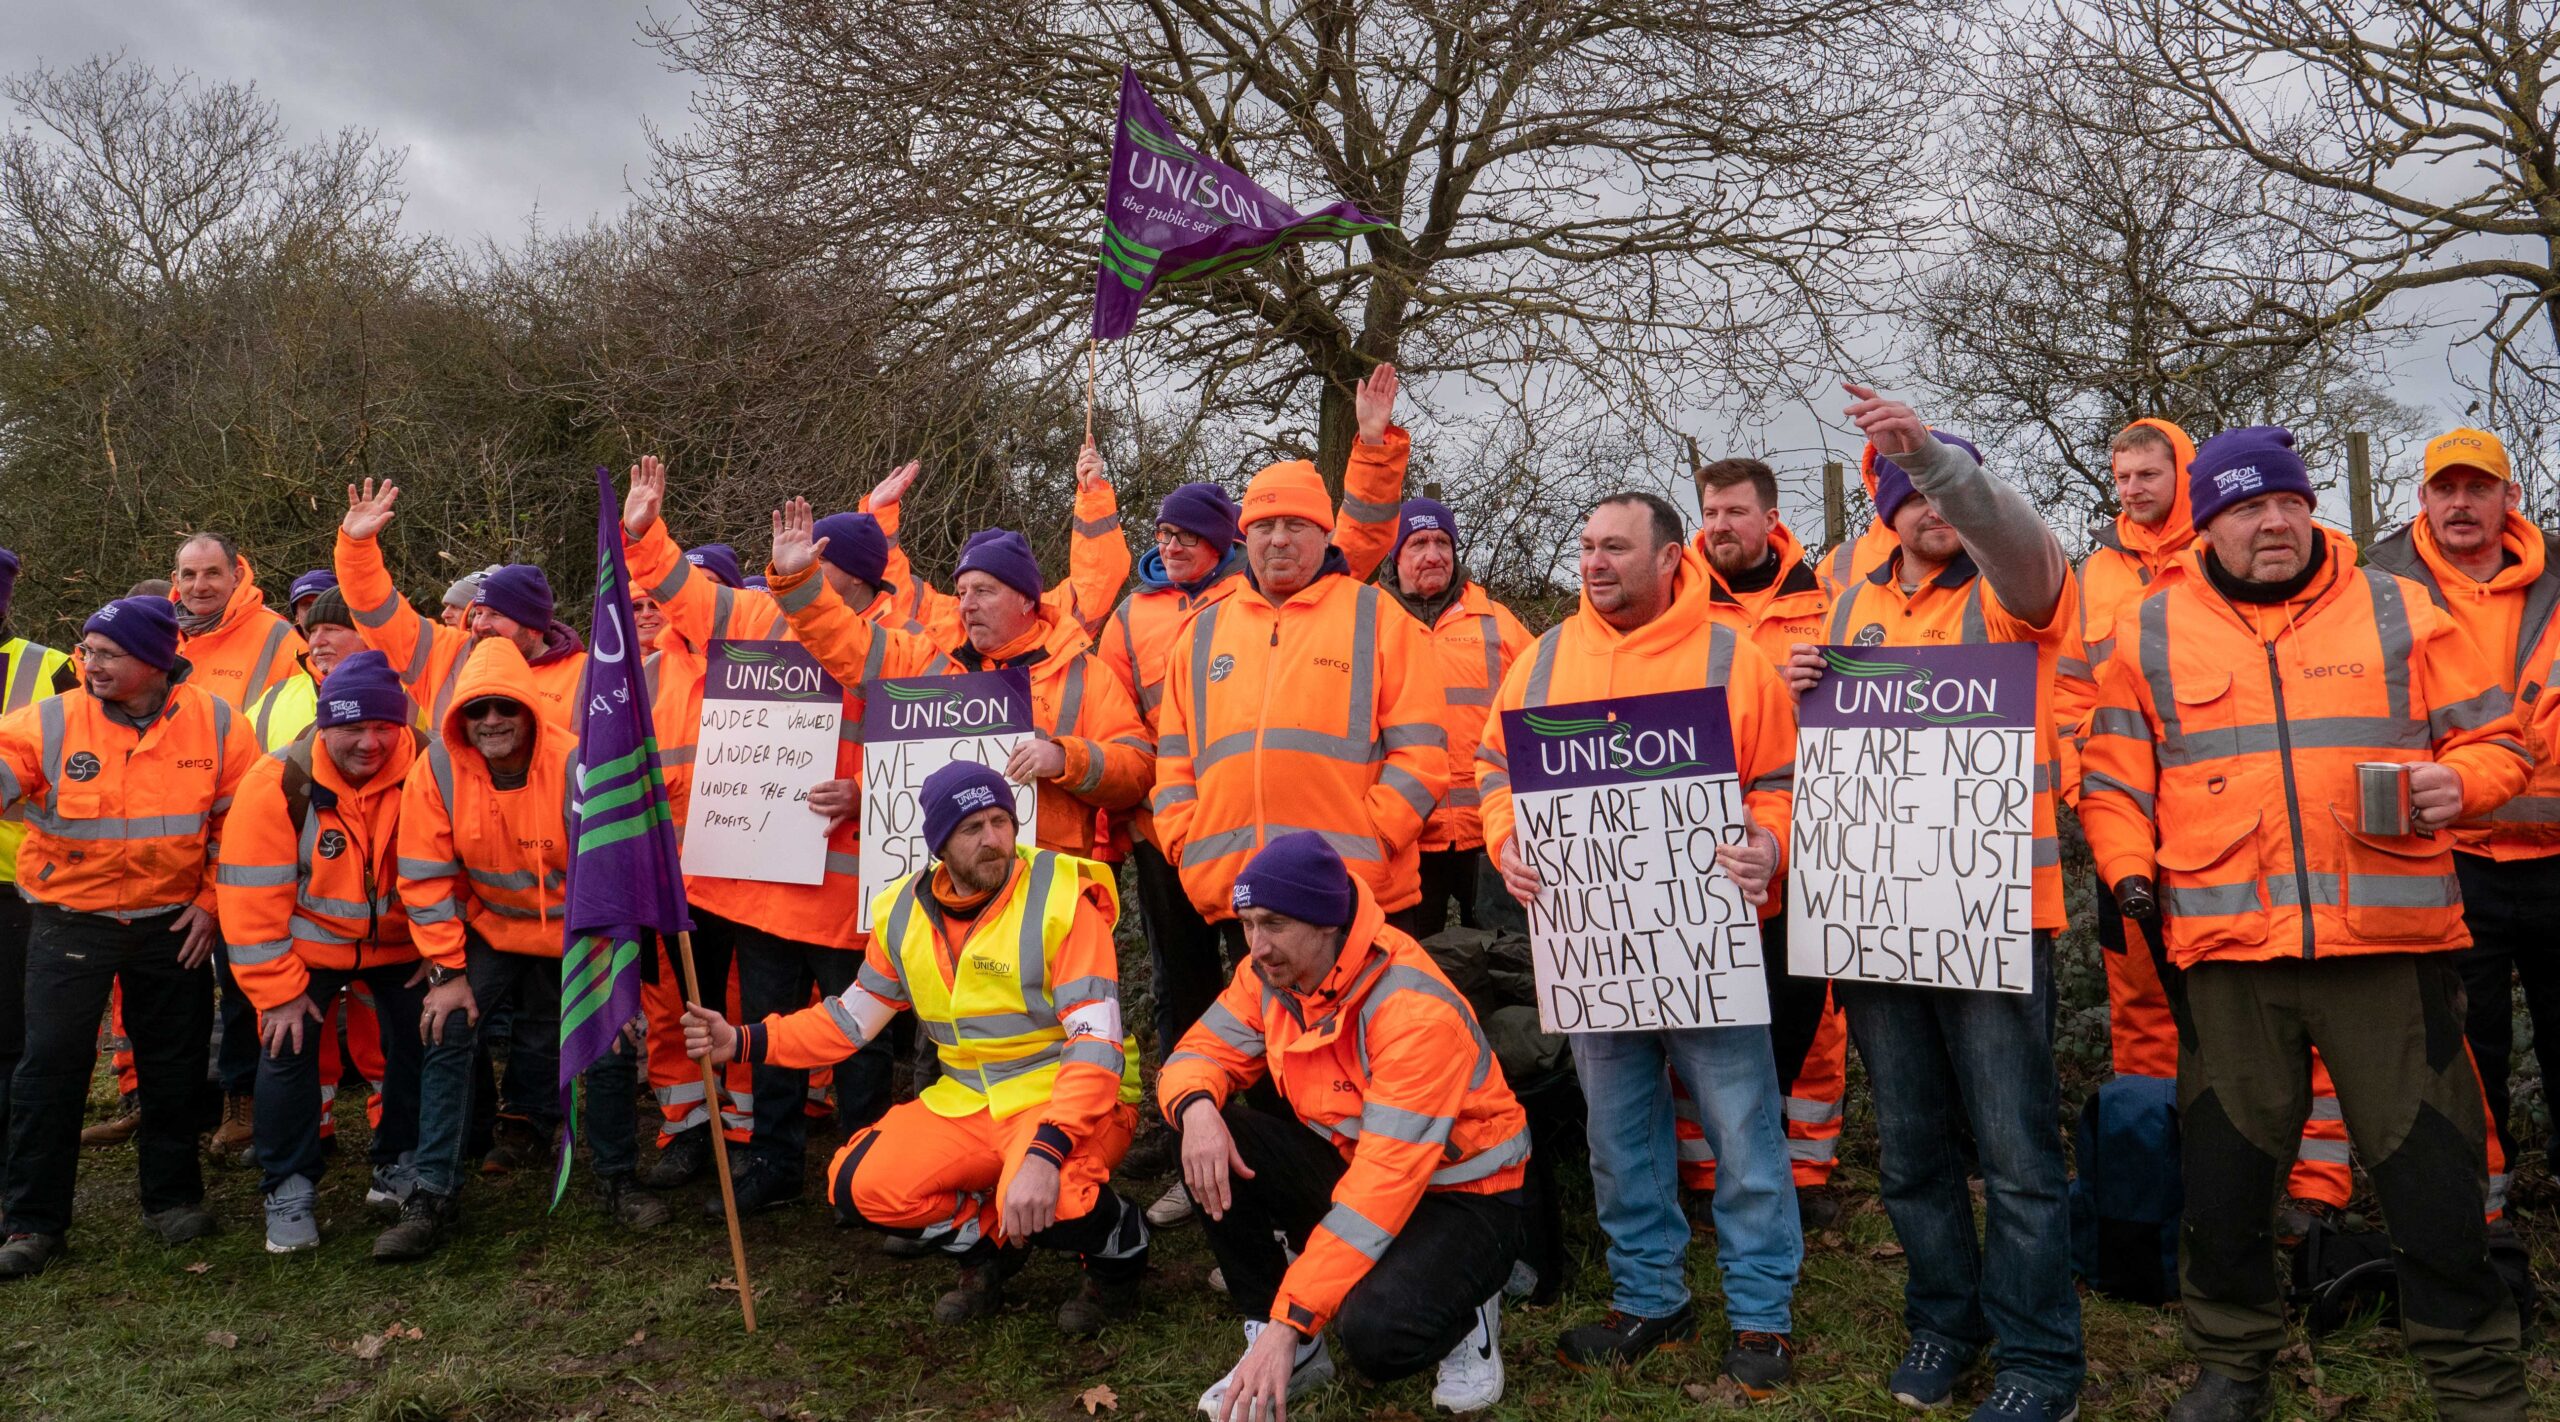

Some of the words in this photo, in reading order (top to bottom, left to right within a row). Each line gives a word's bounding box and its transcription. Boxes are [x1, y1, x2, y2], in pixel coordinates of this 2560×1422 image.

[1122, 196, 1144, 214] the
[1145, 206, 1190, 228] public
[1129, 151, 1262, 228] UNISON
[211, 668, 243, 680] serco
[726, 664, 821, 691] UNISON
[1313, 656, 1350, 673] serco
[2303, 663, 2365, 679] serco
[702, 708, 769, 730] UNDER
[787, 709, 834, 731] VALUED
[891, 696, 1008, 730] UNISON
[1835, 678, 1997, 713] UNISON
[176, 758, 213, 770] serco
[865, 742, 923, 790] WE
[1541, 727, 1697, 775] UNISON
[1798, 728, 1849, 775] WE
[1855, 727, 1927, 776] ARE
[1942, 728, 2035, 776] NOT
[700, 781, 748, 798] UNDER
[760, 782, 787, 800] THE
[869, 791, 915, 835] NO
[1520, 794, 1577, 839] WE
[1589, 787, 1649, 834] ARE
[1661, 779, 1739, 828] NOT
[1792, 775, 1920, 824] ASKING
[1954, 778, 2028, 828] FOR
[1525, 835, 1648, 887] ASKING
[1793, 821, 1895, 874] MUCH
[1918, 826, 2032, 879] JUST
[1531, 883, 1635, 935] MUCH
[1654, 875, 1749, 927] JUST
[1800, 870, 1923, 925] WHAT
[1955, 879, 2031, 935] WE
[973, 960, 1011, 971] UNISON
[1548, 929, 1664, 980] WHAT
[1676, 922, 1760, 971] WE
[1824, 923, 2024, 991] DESERVE
[1551, 972, 1736, 1029] DESERVE
